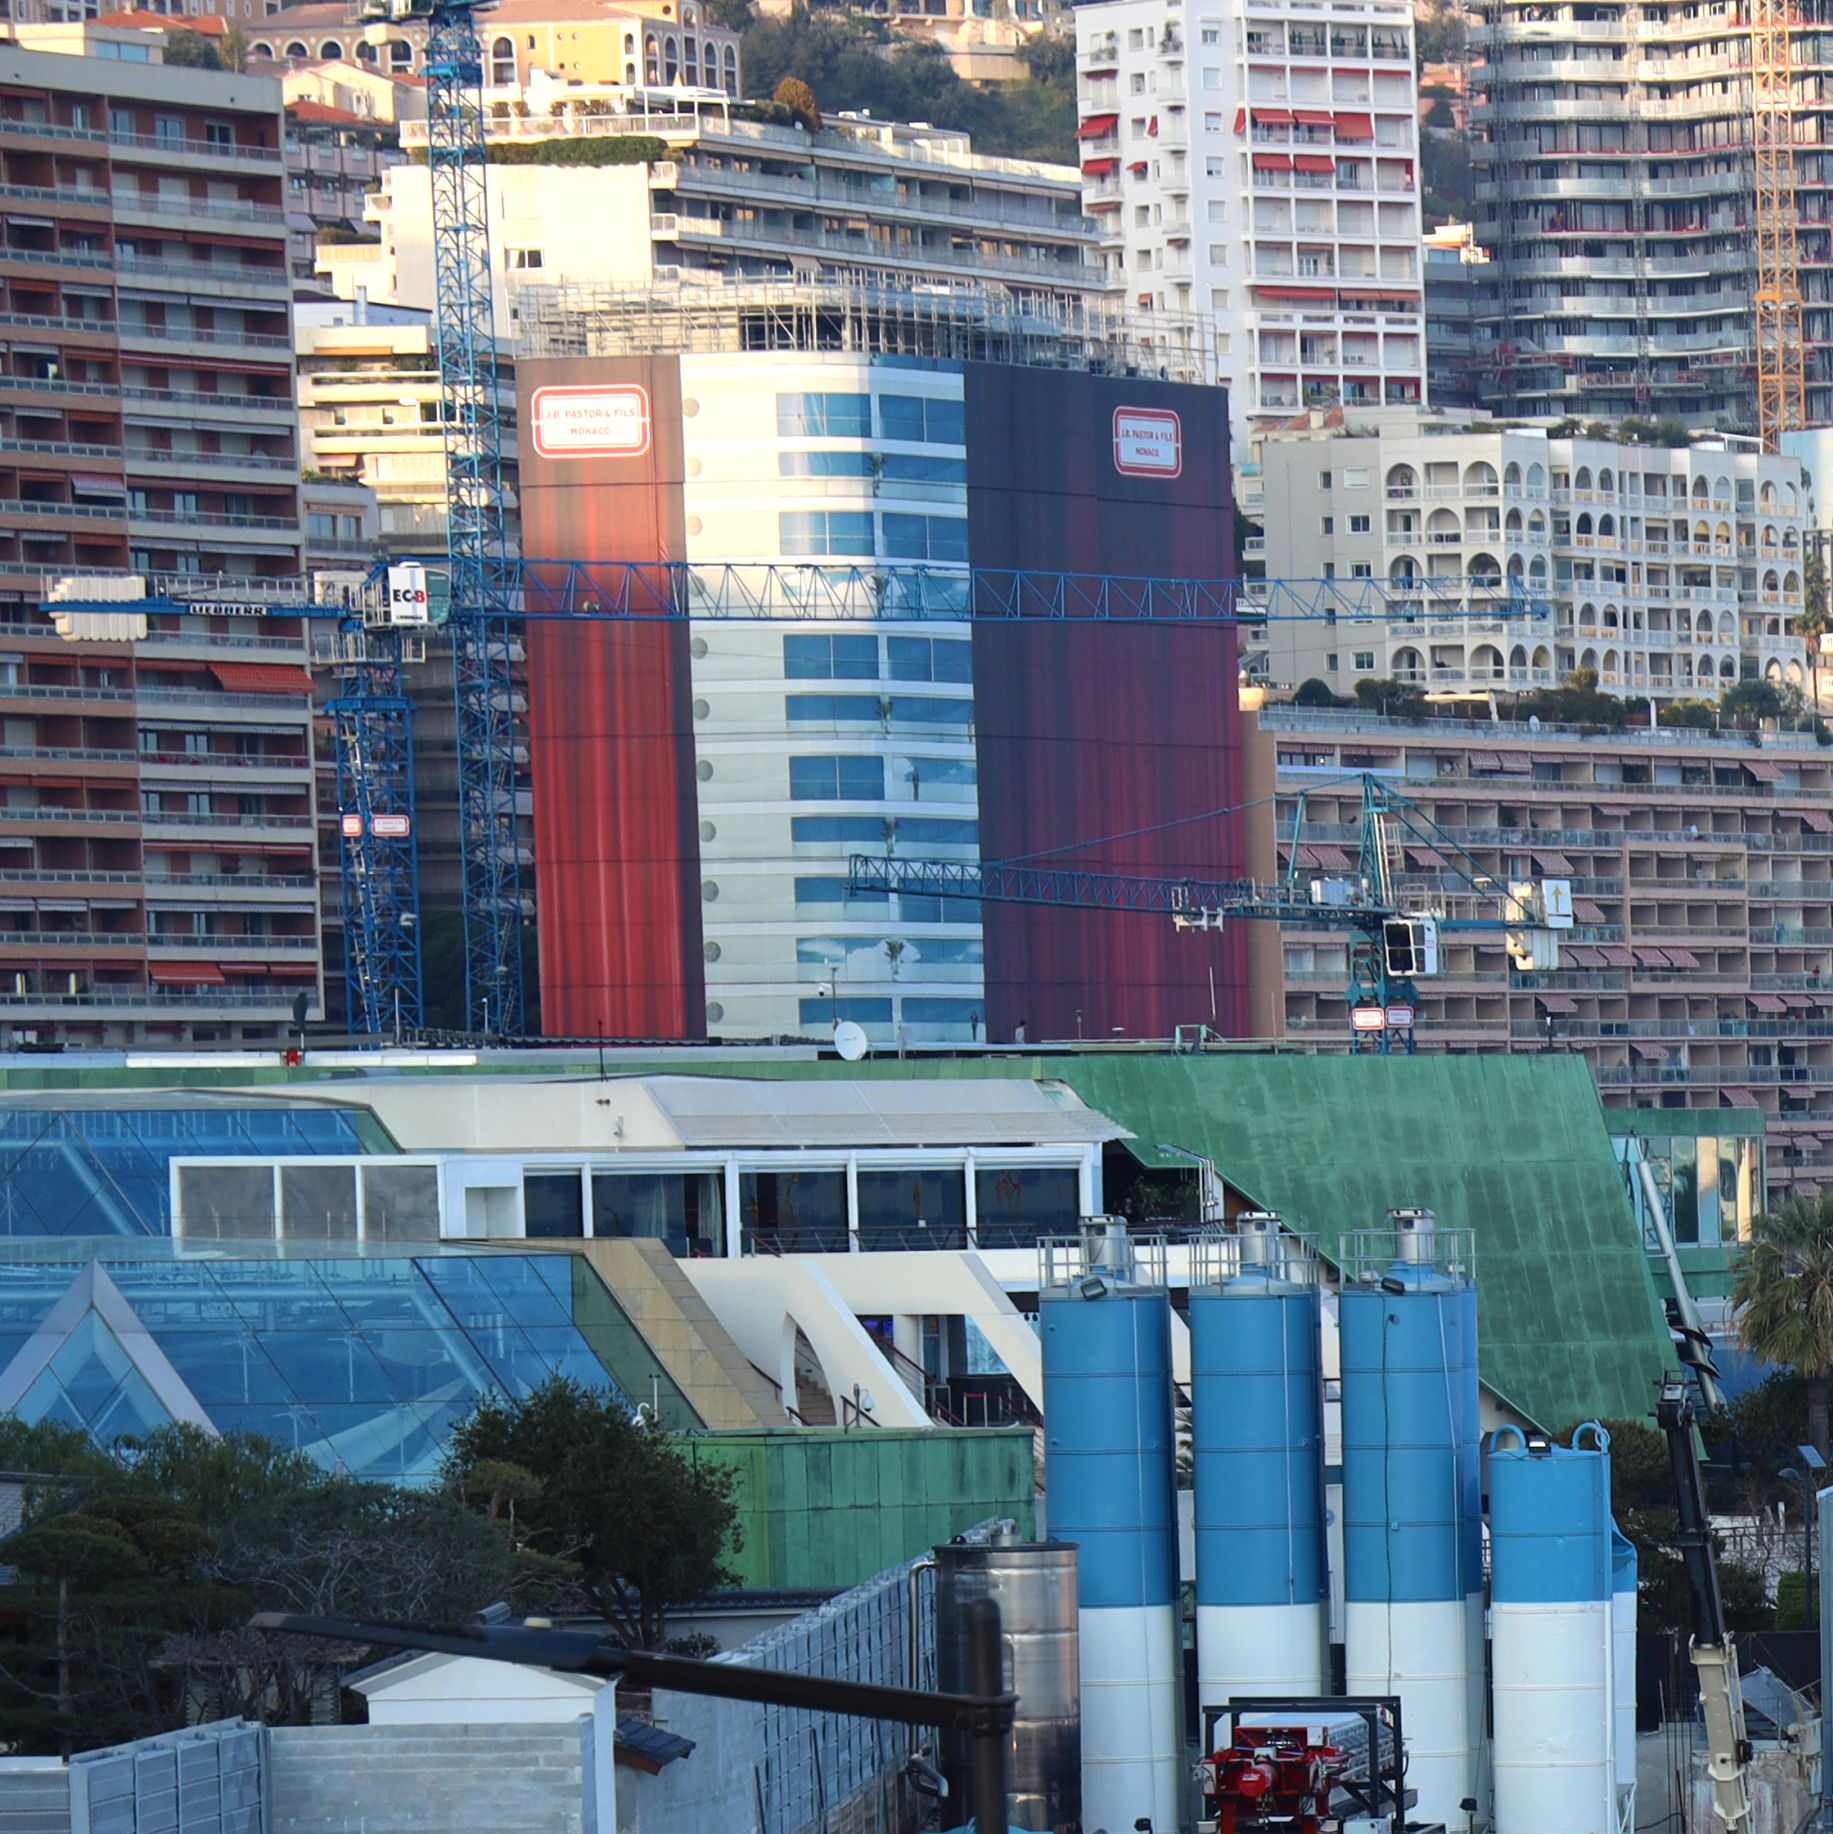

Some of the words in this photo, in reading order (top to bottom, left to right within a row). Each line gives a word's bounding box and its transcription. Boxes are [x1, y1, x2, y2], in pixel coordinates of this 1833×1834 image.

[565, 408, 602, 418] PASTOR
[614, 407, 635, 417] FILS
[570, 426, 611, 435] MONACO
[189, 604, 266, 616] LIEBHERR
